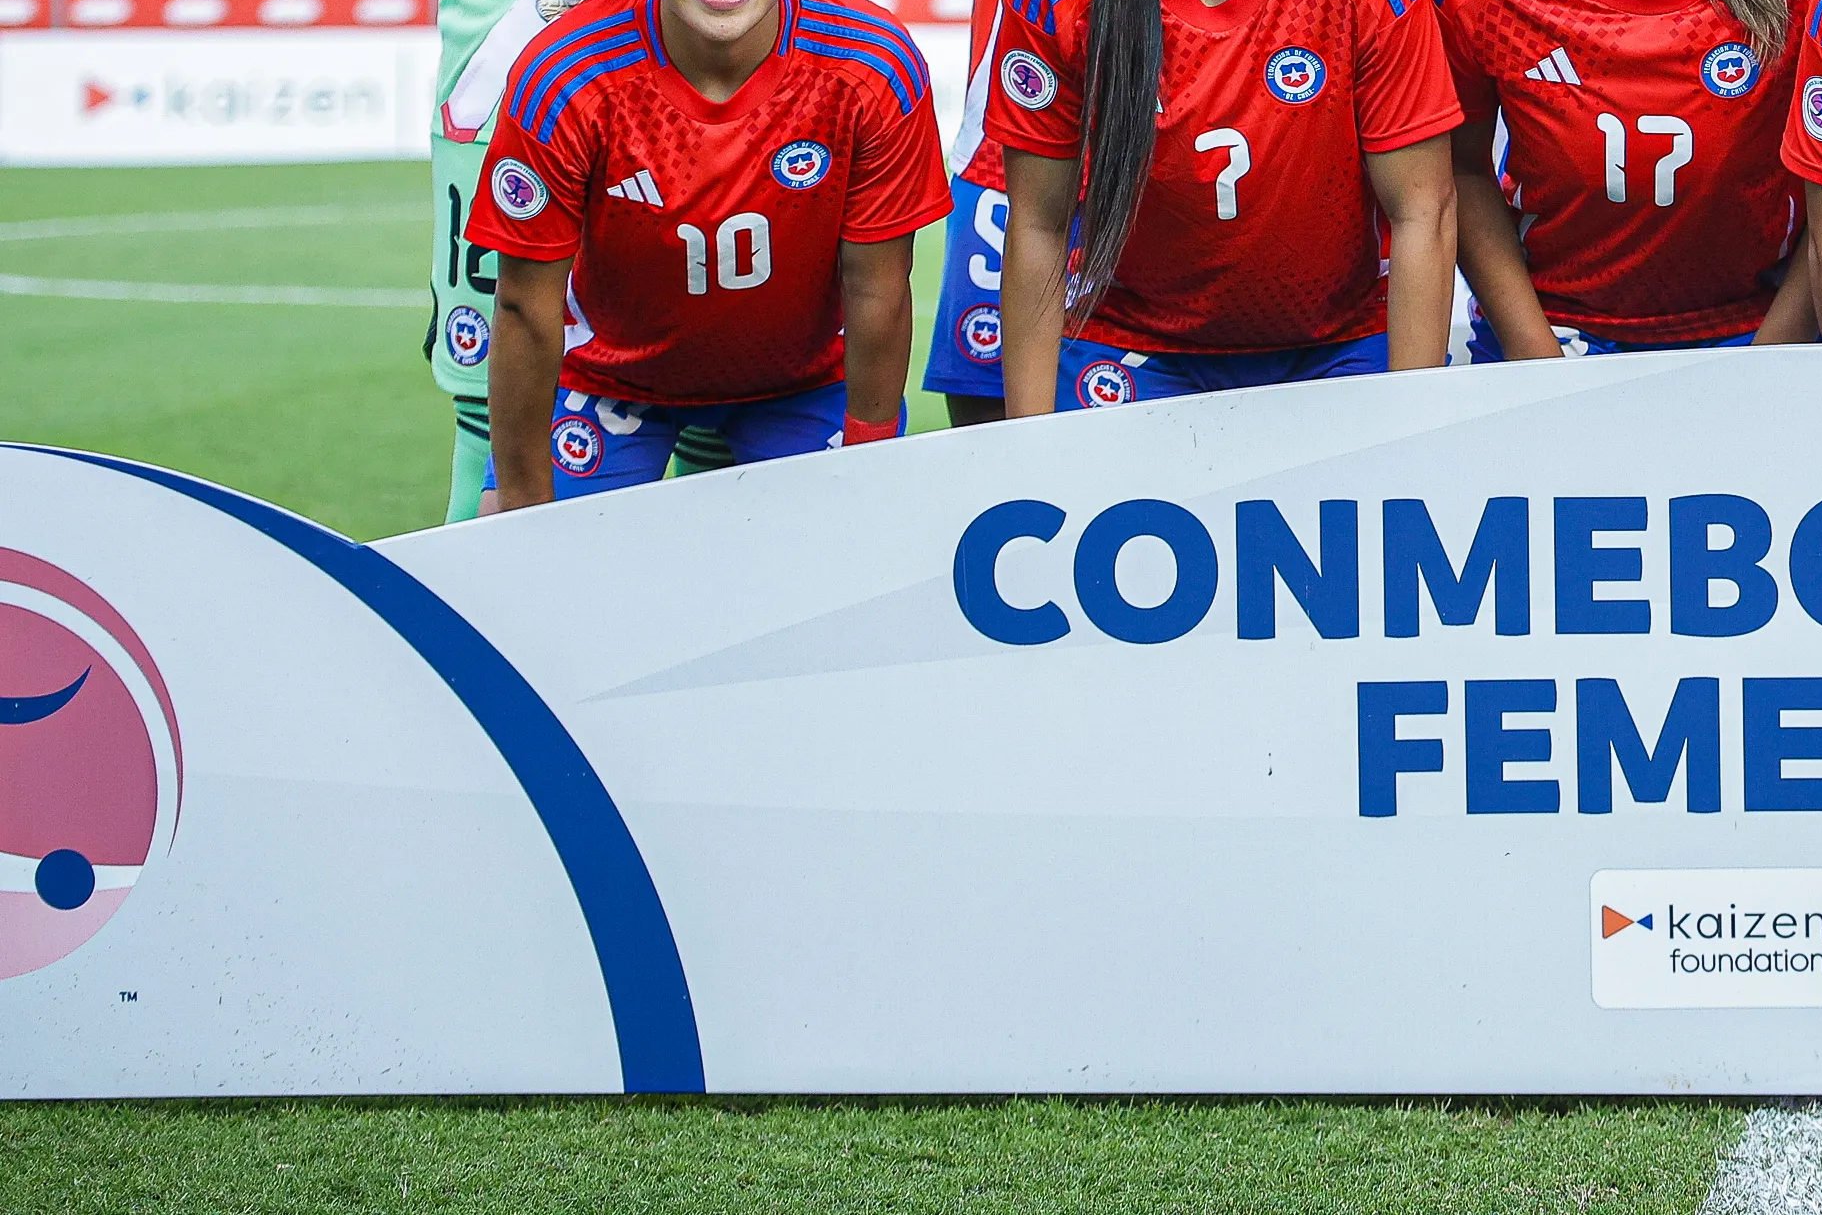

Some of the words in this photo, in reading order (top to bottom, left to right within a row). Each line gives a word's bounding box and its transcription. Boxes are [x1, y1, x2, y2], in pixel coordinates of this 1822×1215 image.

[1194, 127, 1252, 220] 7
[1596, 113, 1694, 207] 17
[676, 211, 774, 295] 10
